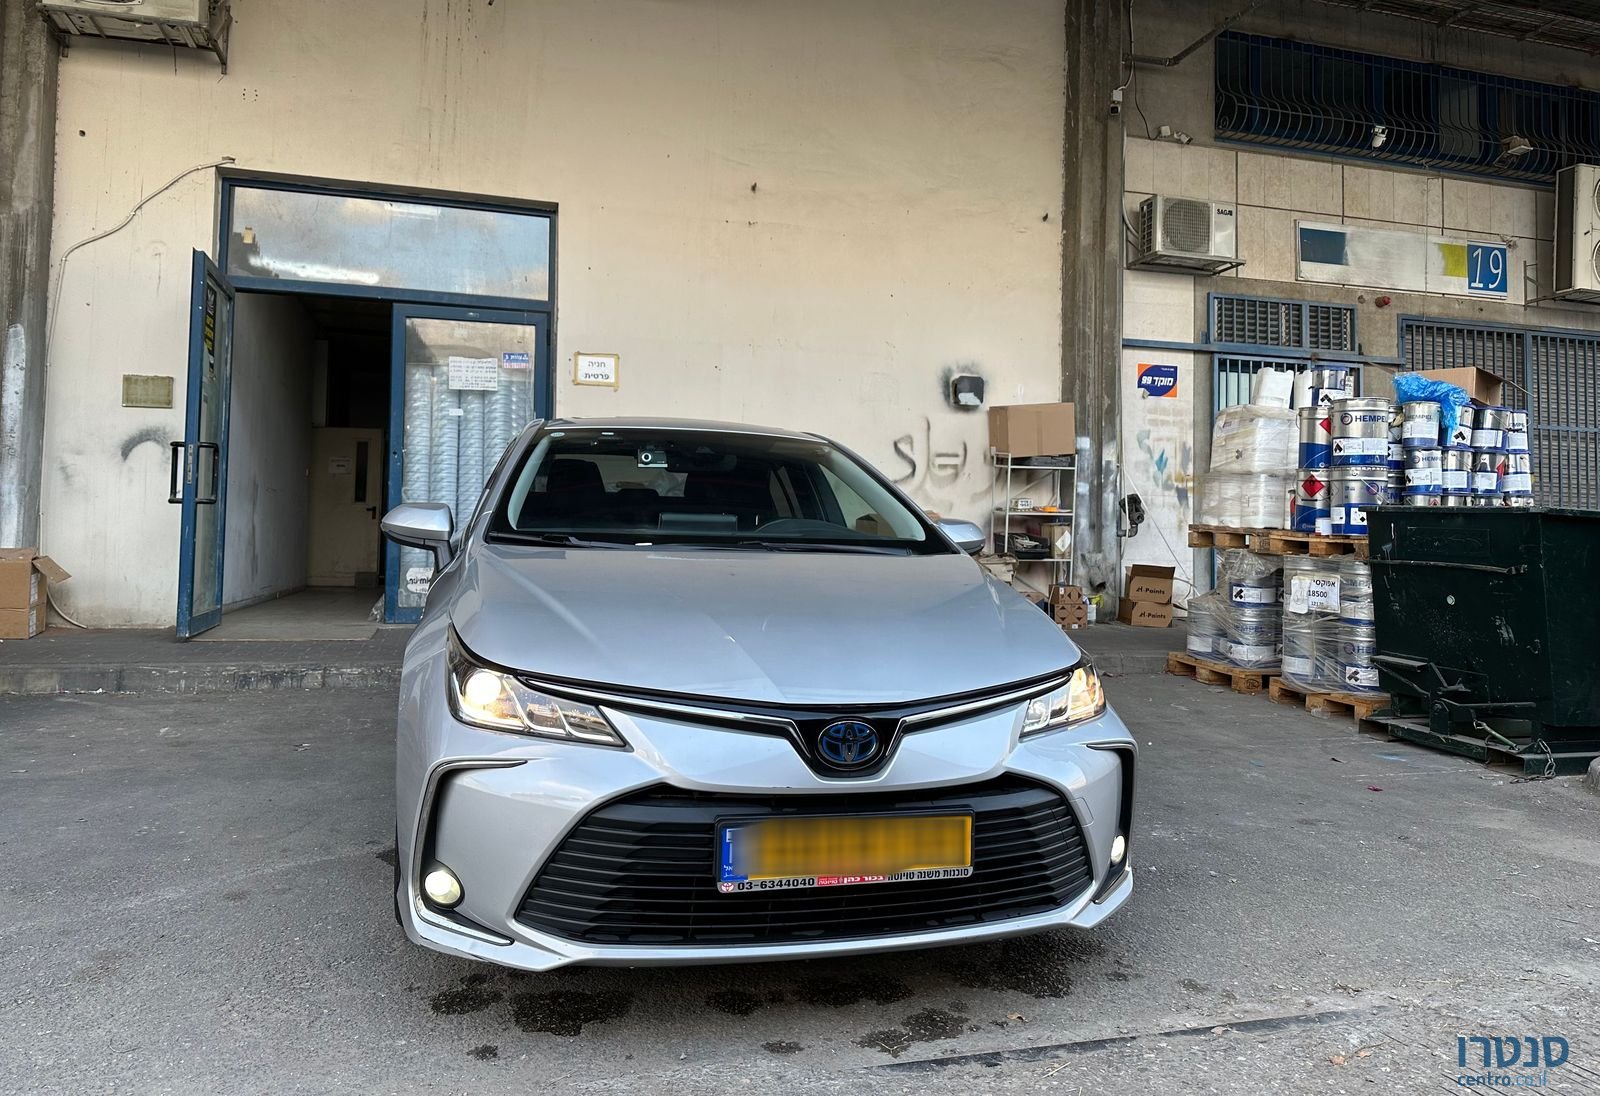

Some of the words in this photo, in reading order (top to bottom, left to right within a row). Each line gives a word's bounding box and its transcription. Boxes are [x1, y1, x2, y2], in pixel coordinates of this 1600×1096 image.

[1471, 248, 1502, 288] 19
[588, 360, 606, 368] חניה
[584, 372, 610, 380] פרטית
[1141, 376, 1153, 385] 99
[1153, 377, 1174, 387] מוקד
[1308, 589, 1328, 599] 18500
[917, 869, 940, 879] משנה
[942, 868, 969, 878] סוכנות
[737, 877, 815, 891] 03-6344040
